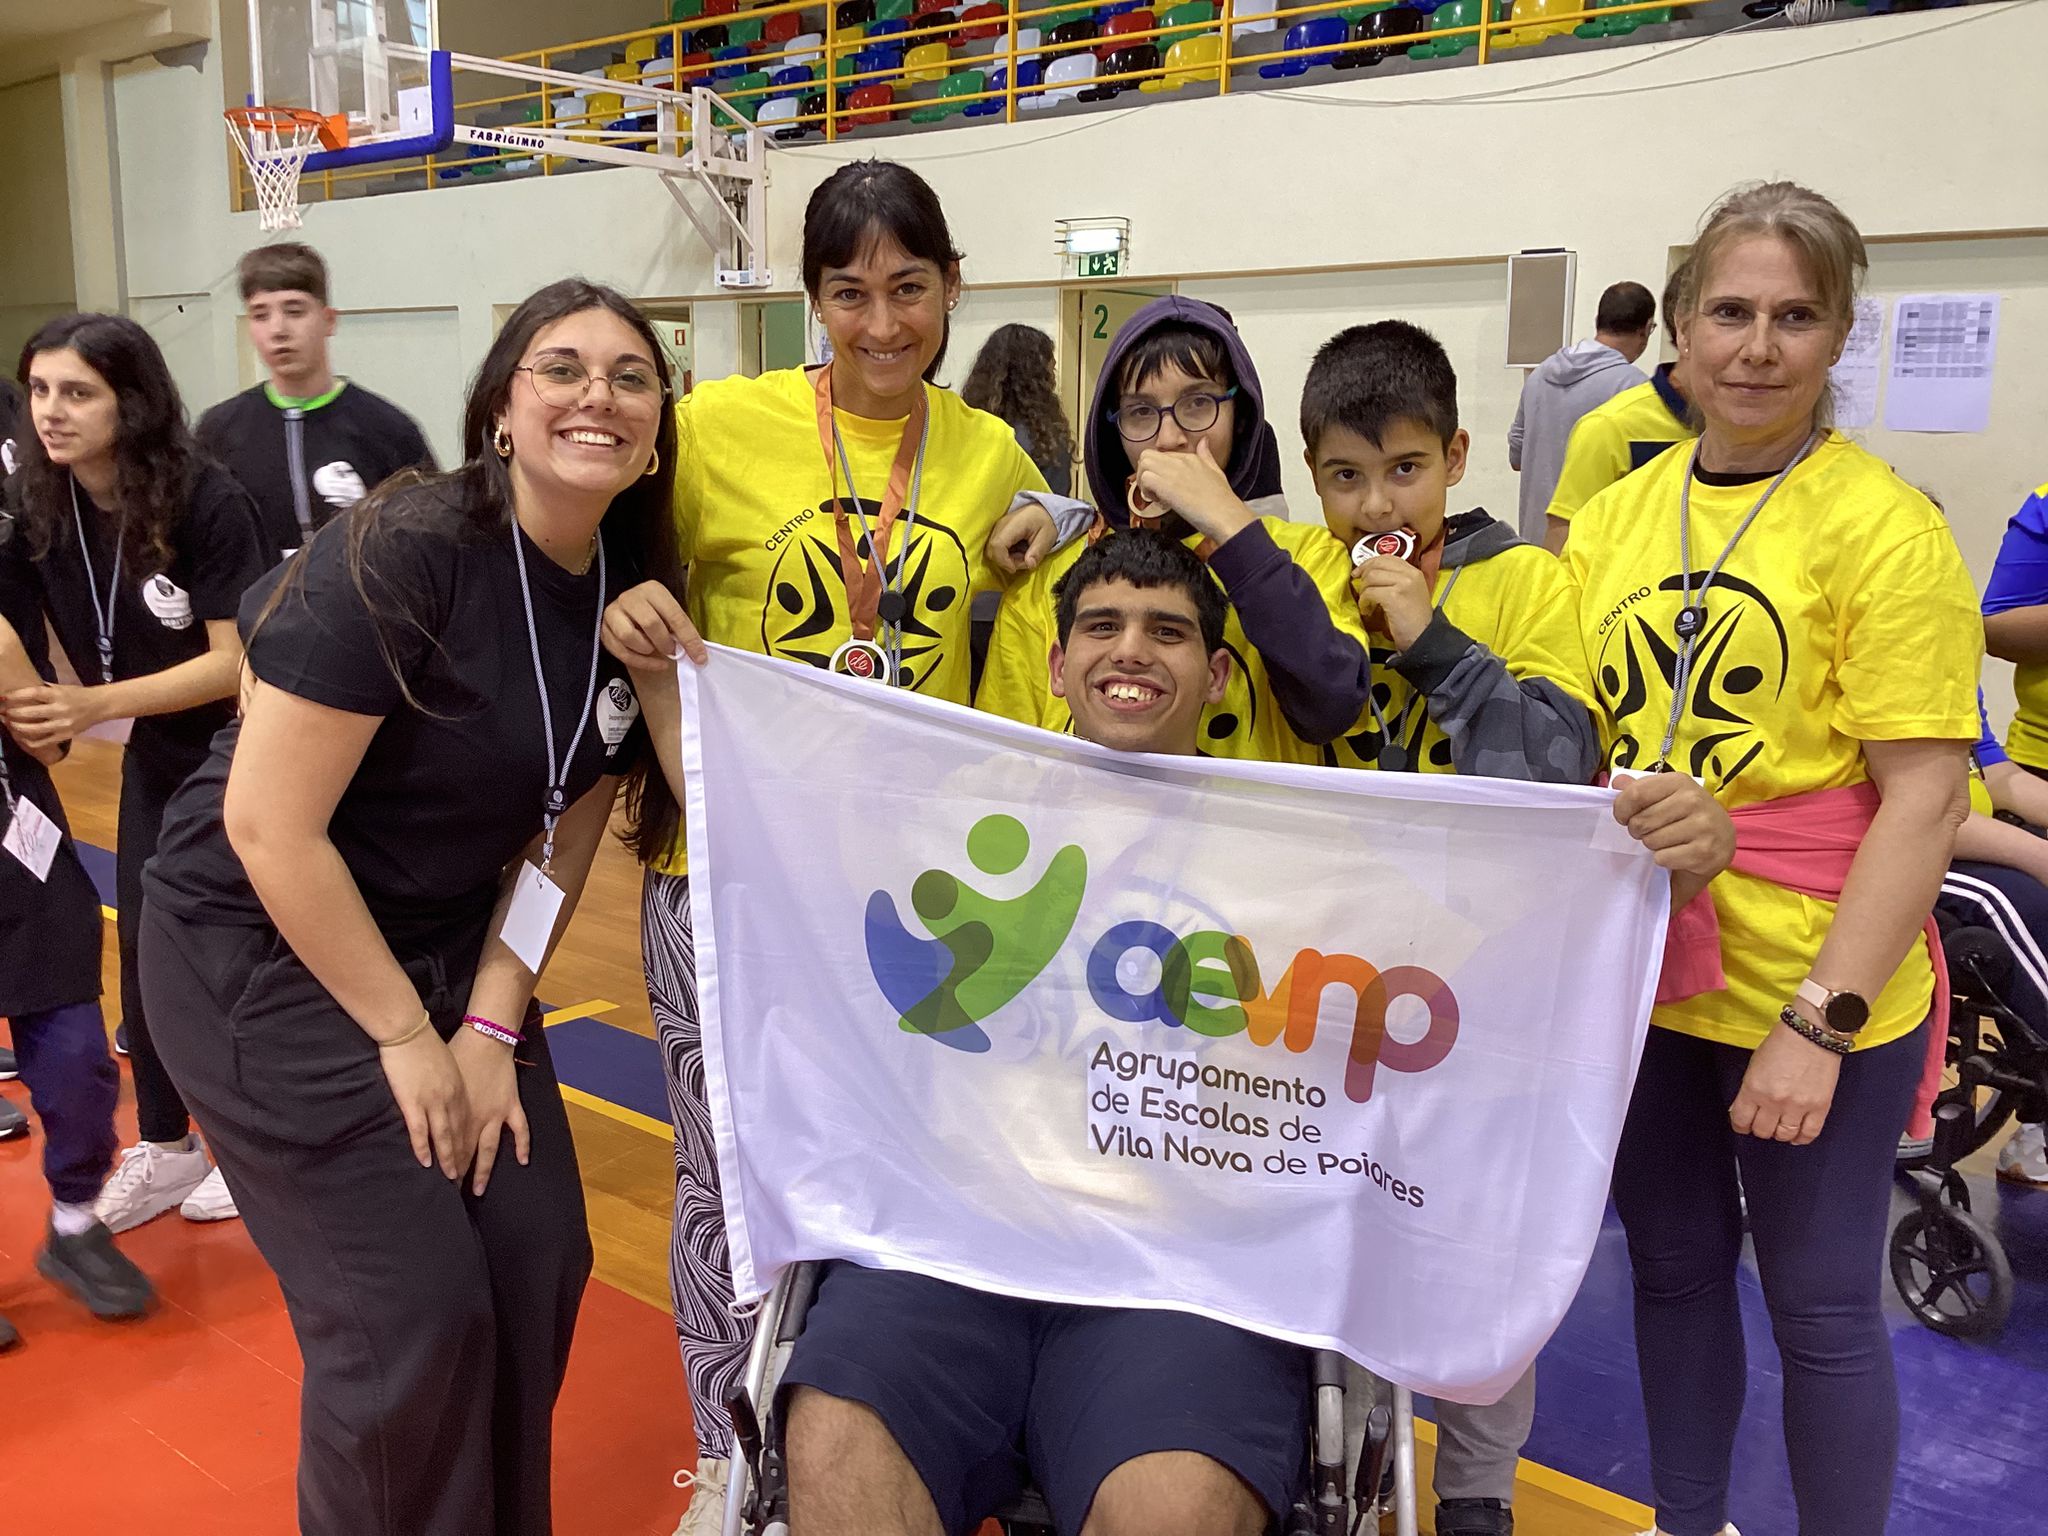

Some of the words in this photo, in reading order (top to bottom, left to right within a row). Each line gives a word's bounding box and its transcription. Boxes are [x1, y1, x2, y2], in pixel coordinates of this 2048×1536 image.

[470, 130, 544, 148] FABRIGIMNO
[1094, 304, 1108, 338] 2
[765, 508, 814, 552] CENTRO
[1598, 587, 1651, 634] CENTRO
[1090, 1041, 1327, 1109] Agrupamento
[1091, 1084, 1130, 1115] de
[1140, 1087, 1270, 1138] Escolas
[1280, 1116, 1322, 1144] de
[1090, 1124, 1154, 1160] Vila
[1164, 1135, 1253, 1173] Nova
[1263, 1149, 1308, 1176] de
[1318, 1151, 1425, 1209] Poiares
